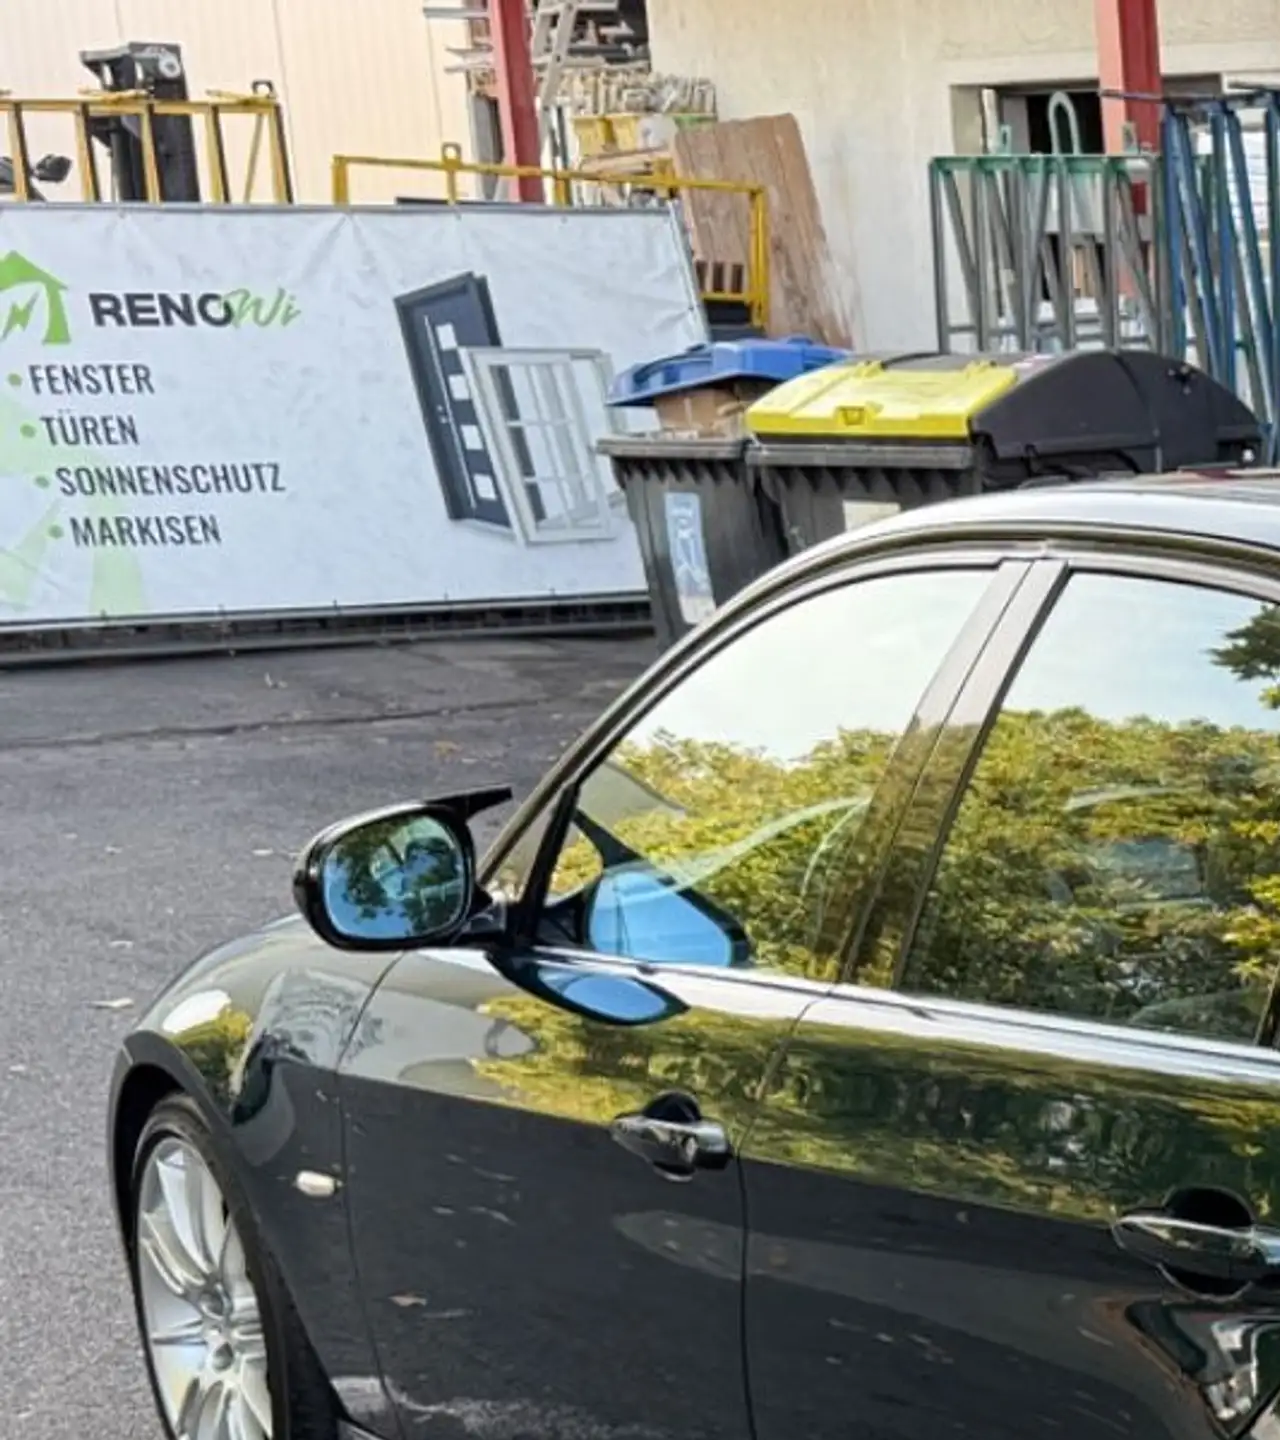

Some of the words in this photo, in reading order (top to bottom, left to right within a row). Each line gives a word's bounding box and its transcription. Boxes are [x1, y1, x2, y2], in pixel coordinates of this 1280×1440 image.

[28, 363, 155, 395] FENSTER
[39, 408, 140, 446] TÜREN
[55, 463, 286, 497] SONNENSCHUTZ
[70, 514, 222, 548] MARKISEN
